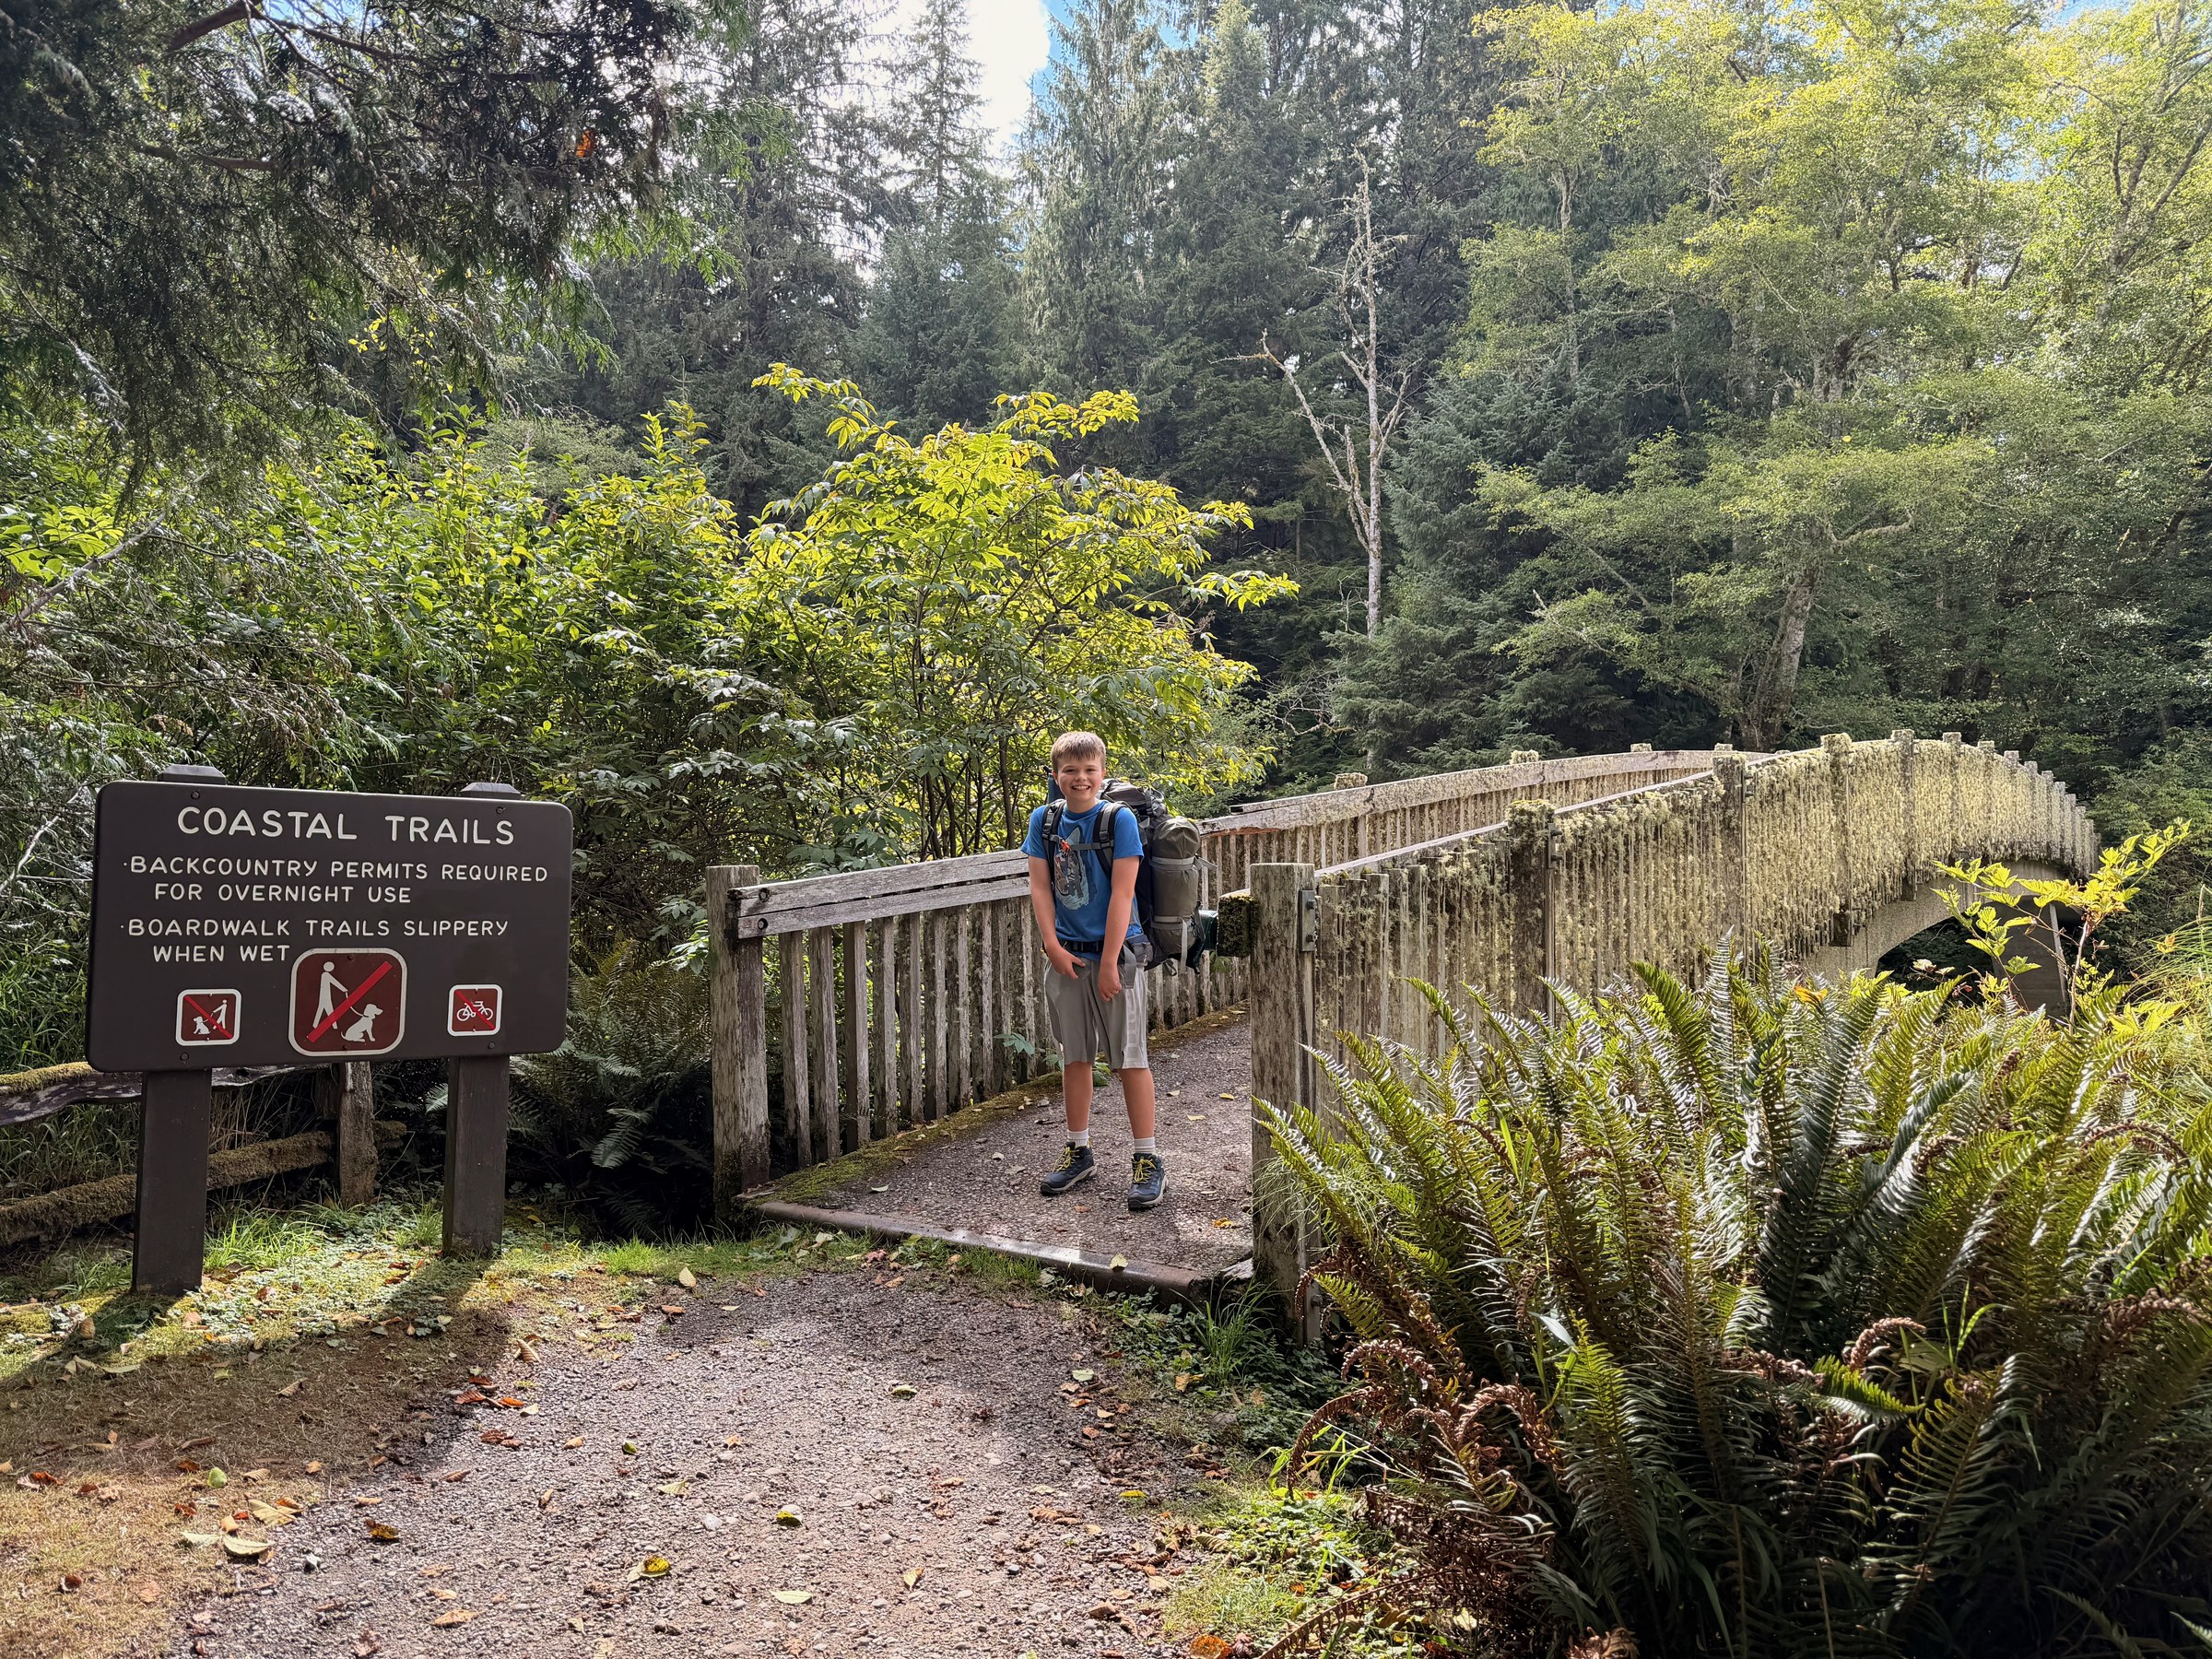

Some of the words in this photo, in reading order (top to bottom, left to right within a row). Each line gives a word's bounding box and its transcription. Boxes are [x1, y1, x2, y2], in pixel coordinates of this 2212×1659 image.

[177, 806, 358, 840] COASTAL
[384, 815, 514, 845] TRAILS
[130, 855, 318, 877] BACKCOUNTRY
[331, 861, 428, 879] PERMITS
[441, 864, 547, 882] REQUIRED
[155, 883, 203, 900] FOR
[218, 884, 354, 902] OVERNIGHT
[368, 886, 411, 903] USE
[128, 918, 290, 936] BOARDWALK
[305, 919, 390, 936] TRAILS
[403, 920, 509, 936] SLIPPERY
[153, 945, 225, 962] WHEN
[240, 945, 290, 962] WET
